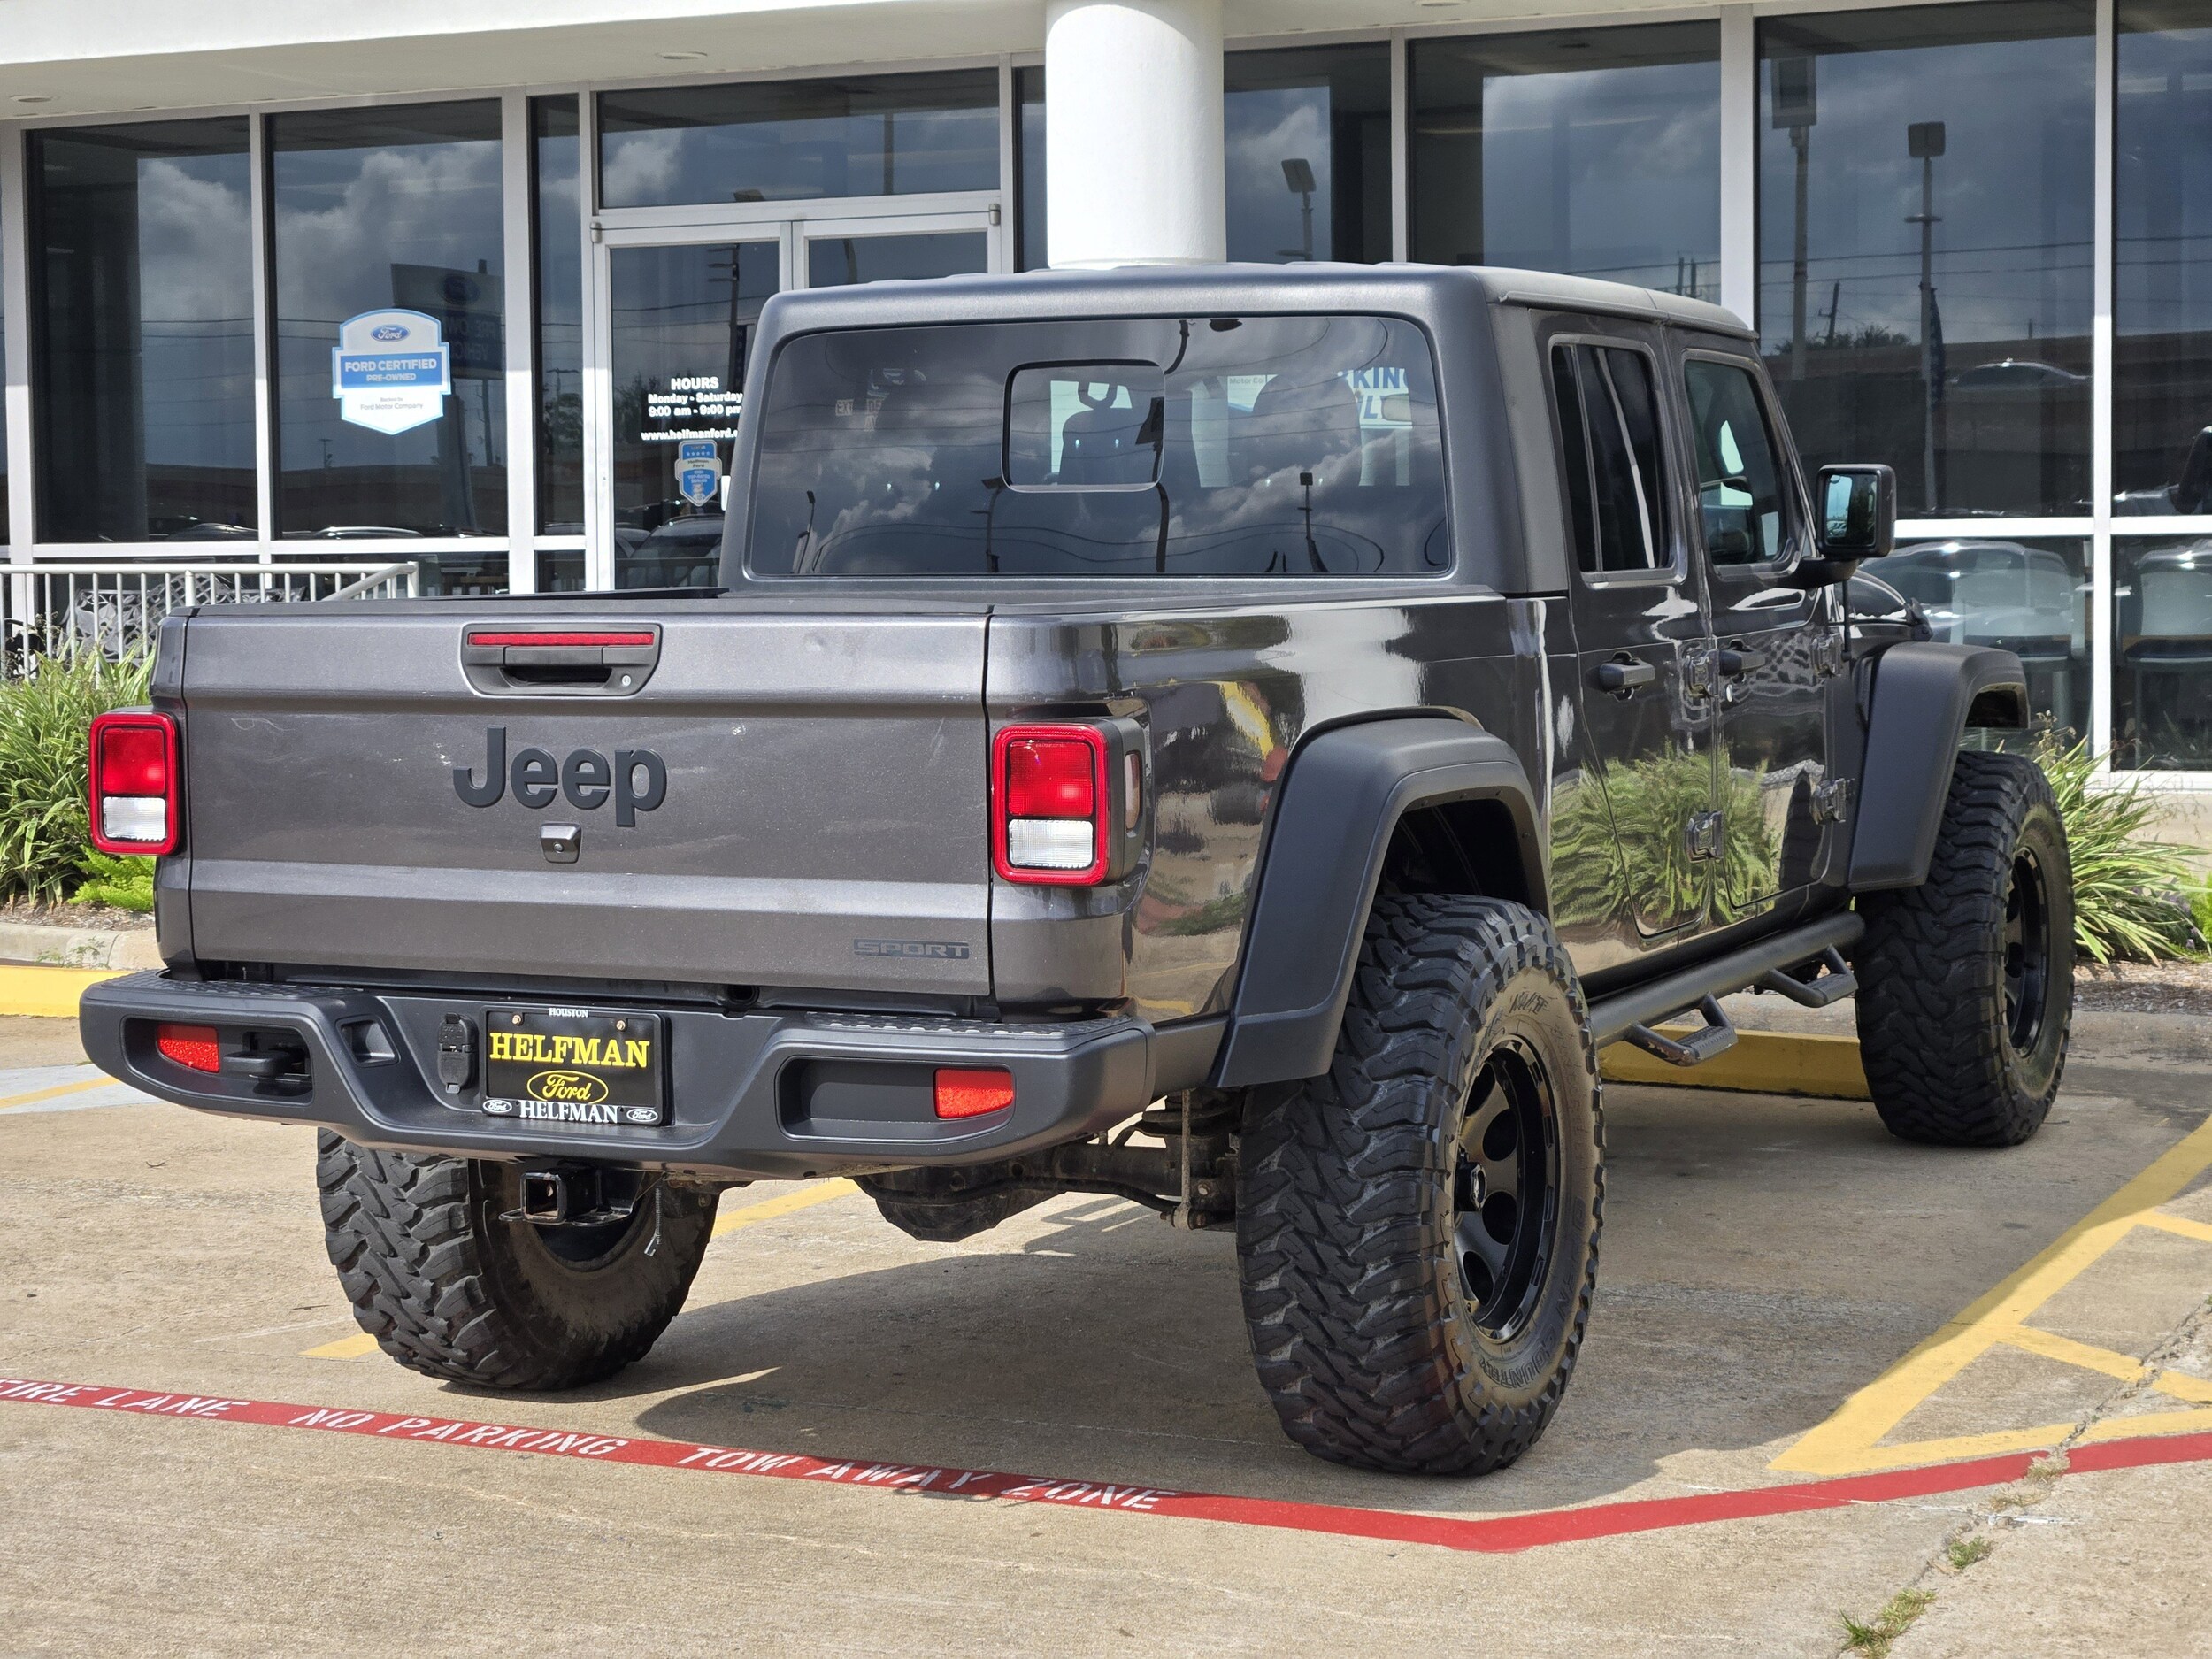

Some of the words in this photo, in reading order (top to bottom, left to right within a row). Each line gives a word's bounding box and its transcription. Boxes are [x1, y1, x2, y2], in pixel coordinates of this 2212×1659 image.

[345, 361, 377, 372] FORD
[378, 358, 437, 371] CERTIFIED
[366, 373, 417, 381] PRE-OWNED
[671, 376, 719, 390] HOURS
[648, 393, 688, 404] Monday
[695, 391, 743, 403] Saturday
[649, 405, 672, 417] 9:00
[673, 407, 692, 416] am
[699, 403, 724, 416] 9:00
[453, 725, 667, 827] Jeep
[854, 941, 969, 957] SPORT
[549, 1007, 588, 1018] HOUSTON
[489, 1032, 650, 1068] HELFMAN
[542, 1073, 592, 1101] Ford
[519, 1099, 621, 1124] HELFMAN
[91, 1390, 250, 1417] LANE
[288, 1409, 375, 1429] NO
[376, 1417, 629, 1455] PARKING
[676, 1448, 804, 1471] TOW
[803, 1462, 994, 1489] AWAY
[1001, 1478, 1178, 1509] ZONE
